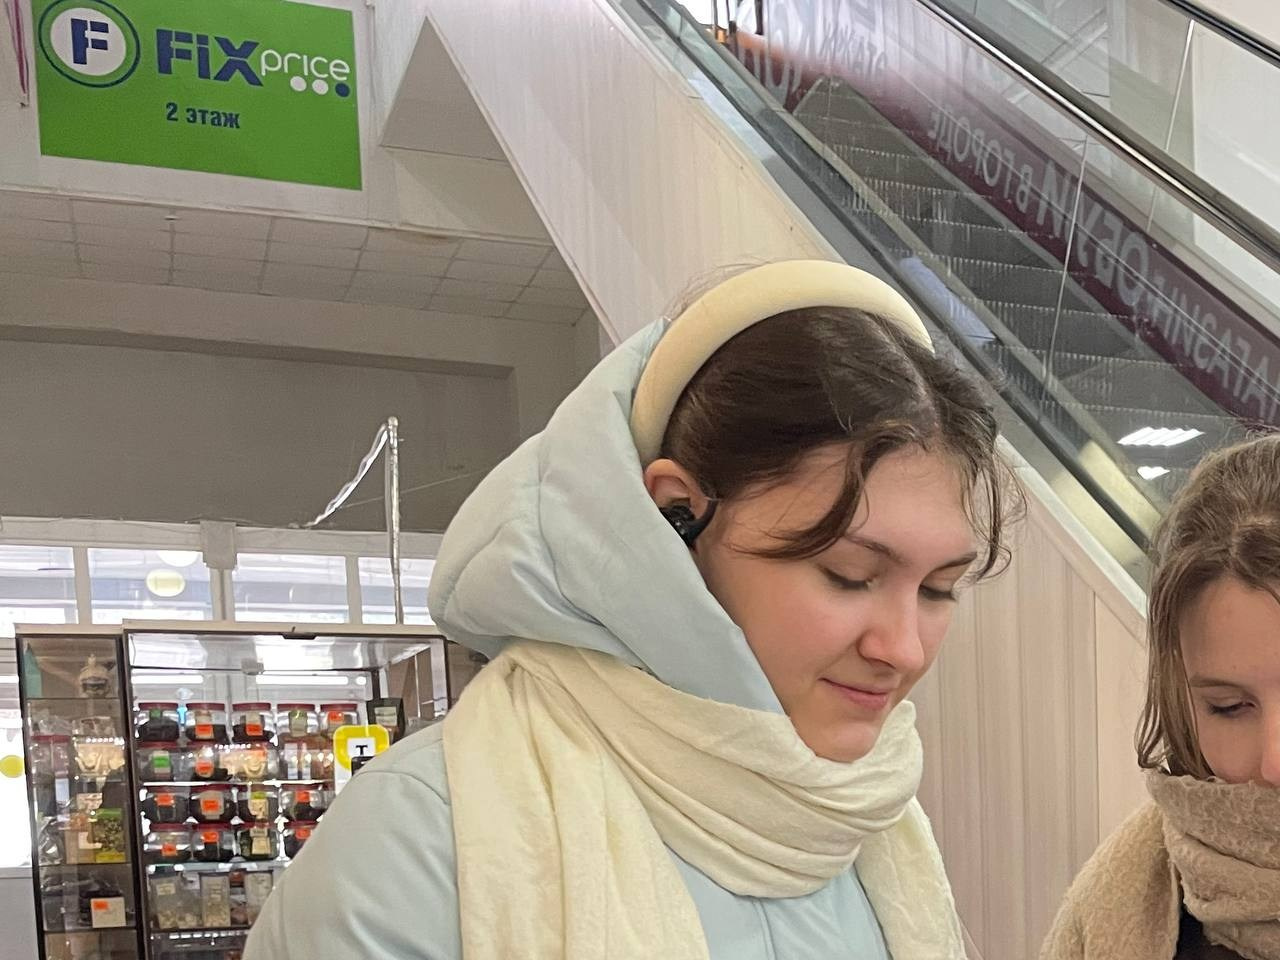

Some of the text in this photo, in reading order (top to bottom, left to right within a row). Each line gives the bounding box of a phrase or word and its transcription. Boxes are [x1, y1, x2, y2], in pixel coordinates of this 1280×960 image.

[71, 18, 109, 65] F
[260, 49, 350, 81] price
[166, 102, 240, 129] 2 этаж
